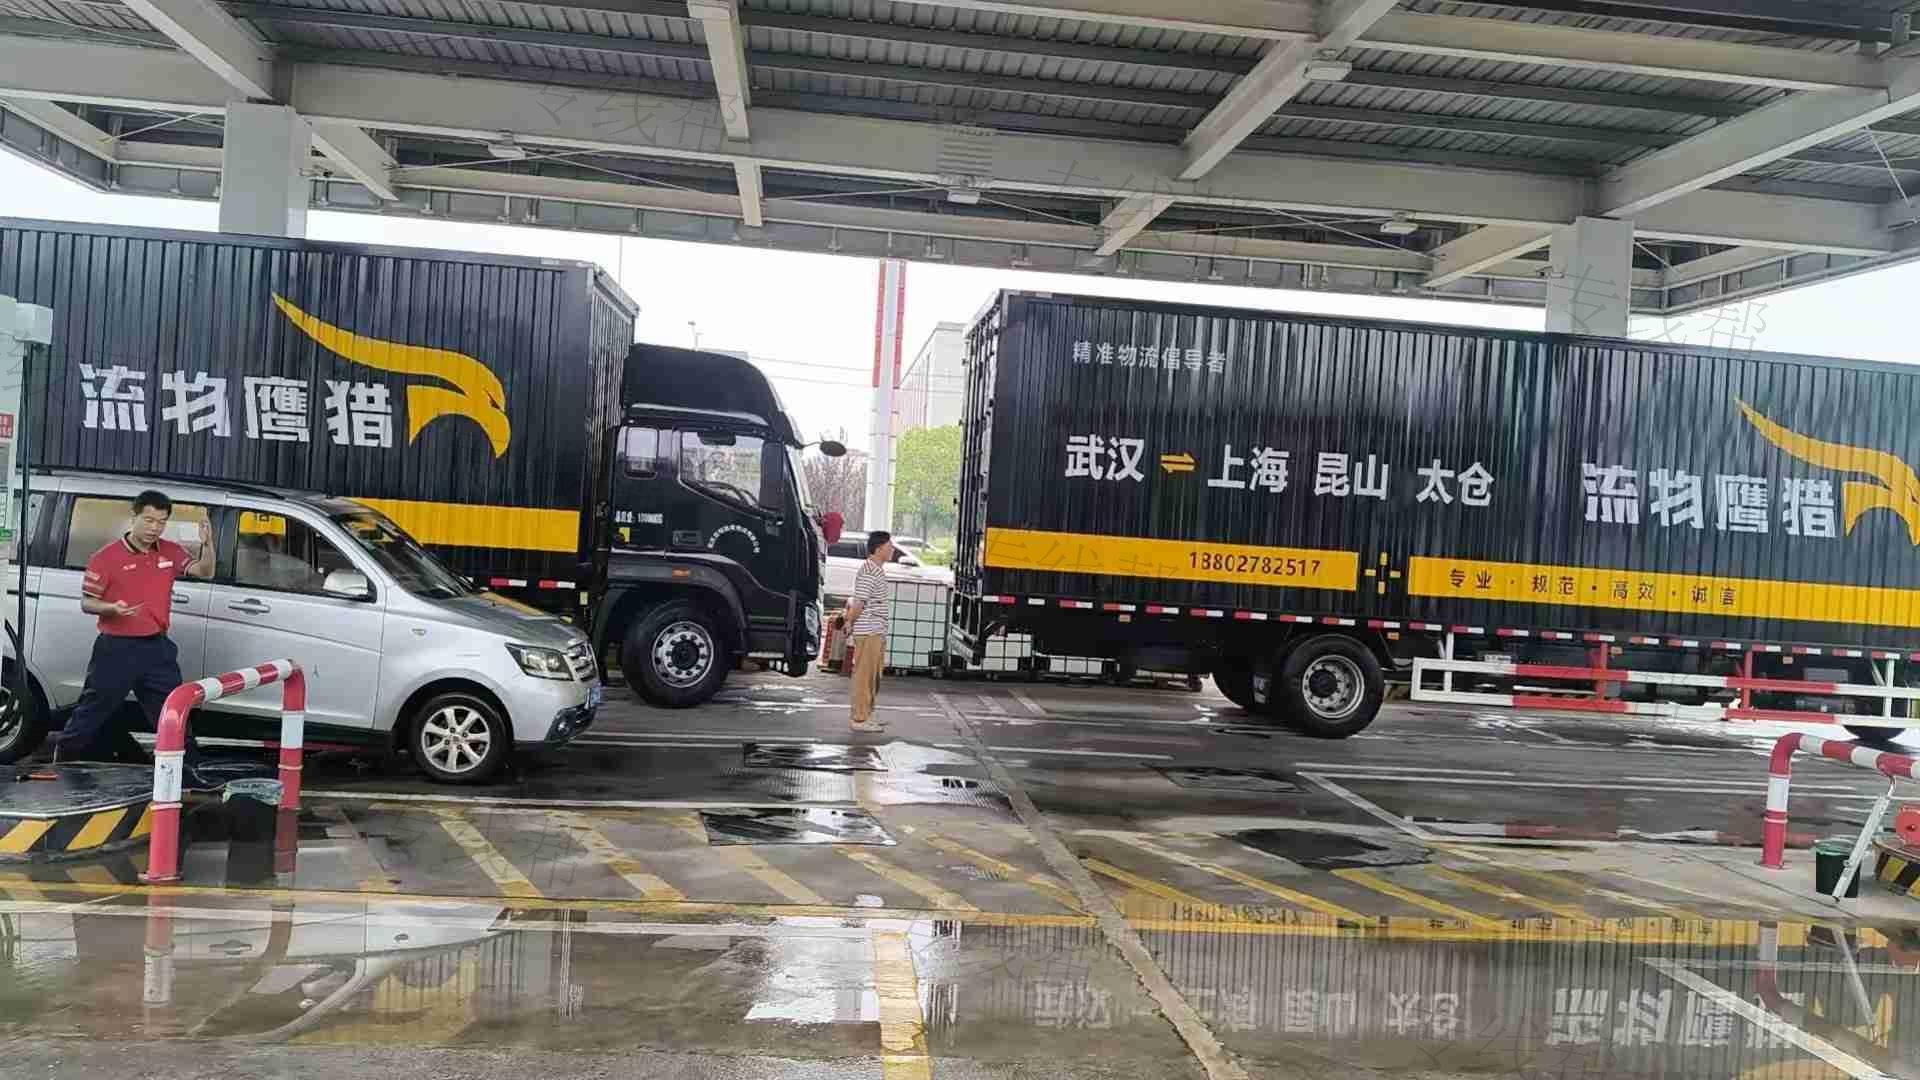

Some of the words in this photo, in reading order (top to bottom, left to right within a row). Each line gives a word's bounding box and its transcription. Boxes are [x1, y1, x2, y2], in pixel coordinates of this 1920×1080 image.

[1072, 339, 1226, 374] 精准物流倡导者
[79, 363, 394, 448] 流物鹰猎
[1064, 434, 1146, 483] 武汉
[1207, 444, 1290, 494] 上海
[1313, 452, 1389, 500] 昆山
[1415, 458, 1495, 506] 太仓
[1582, 462, 1836, 538] 流物鹰猎
[1189, 551, 1321, 577] 18802782517
